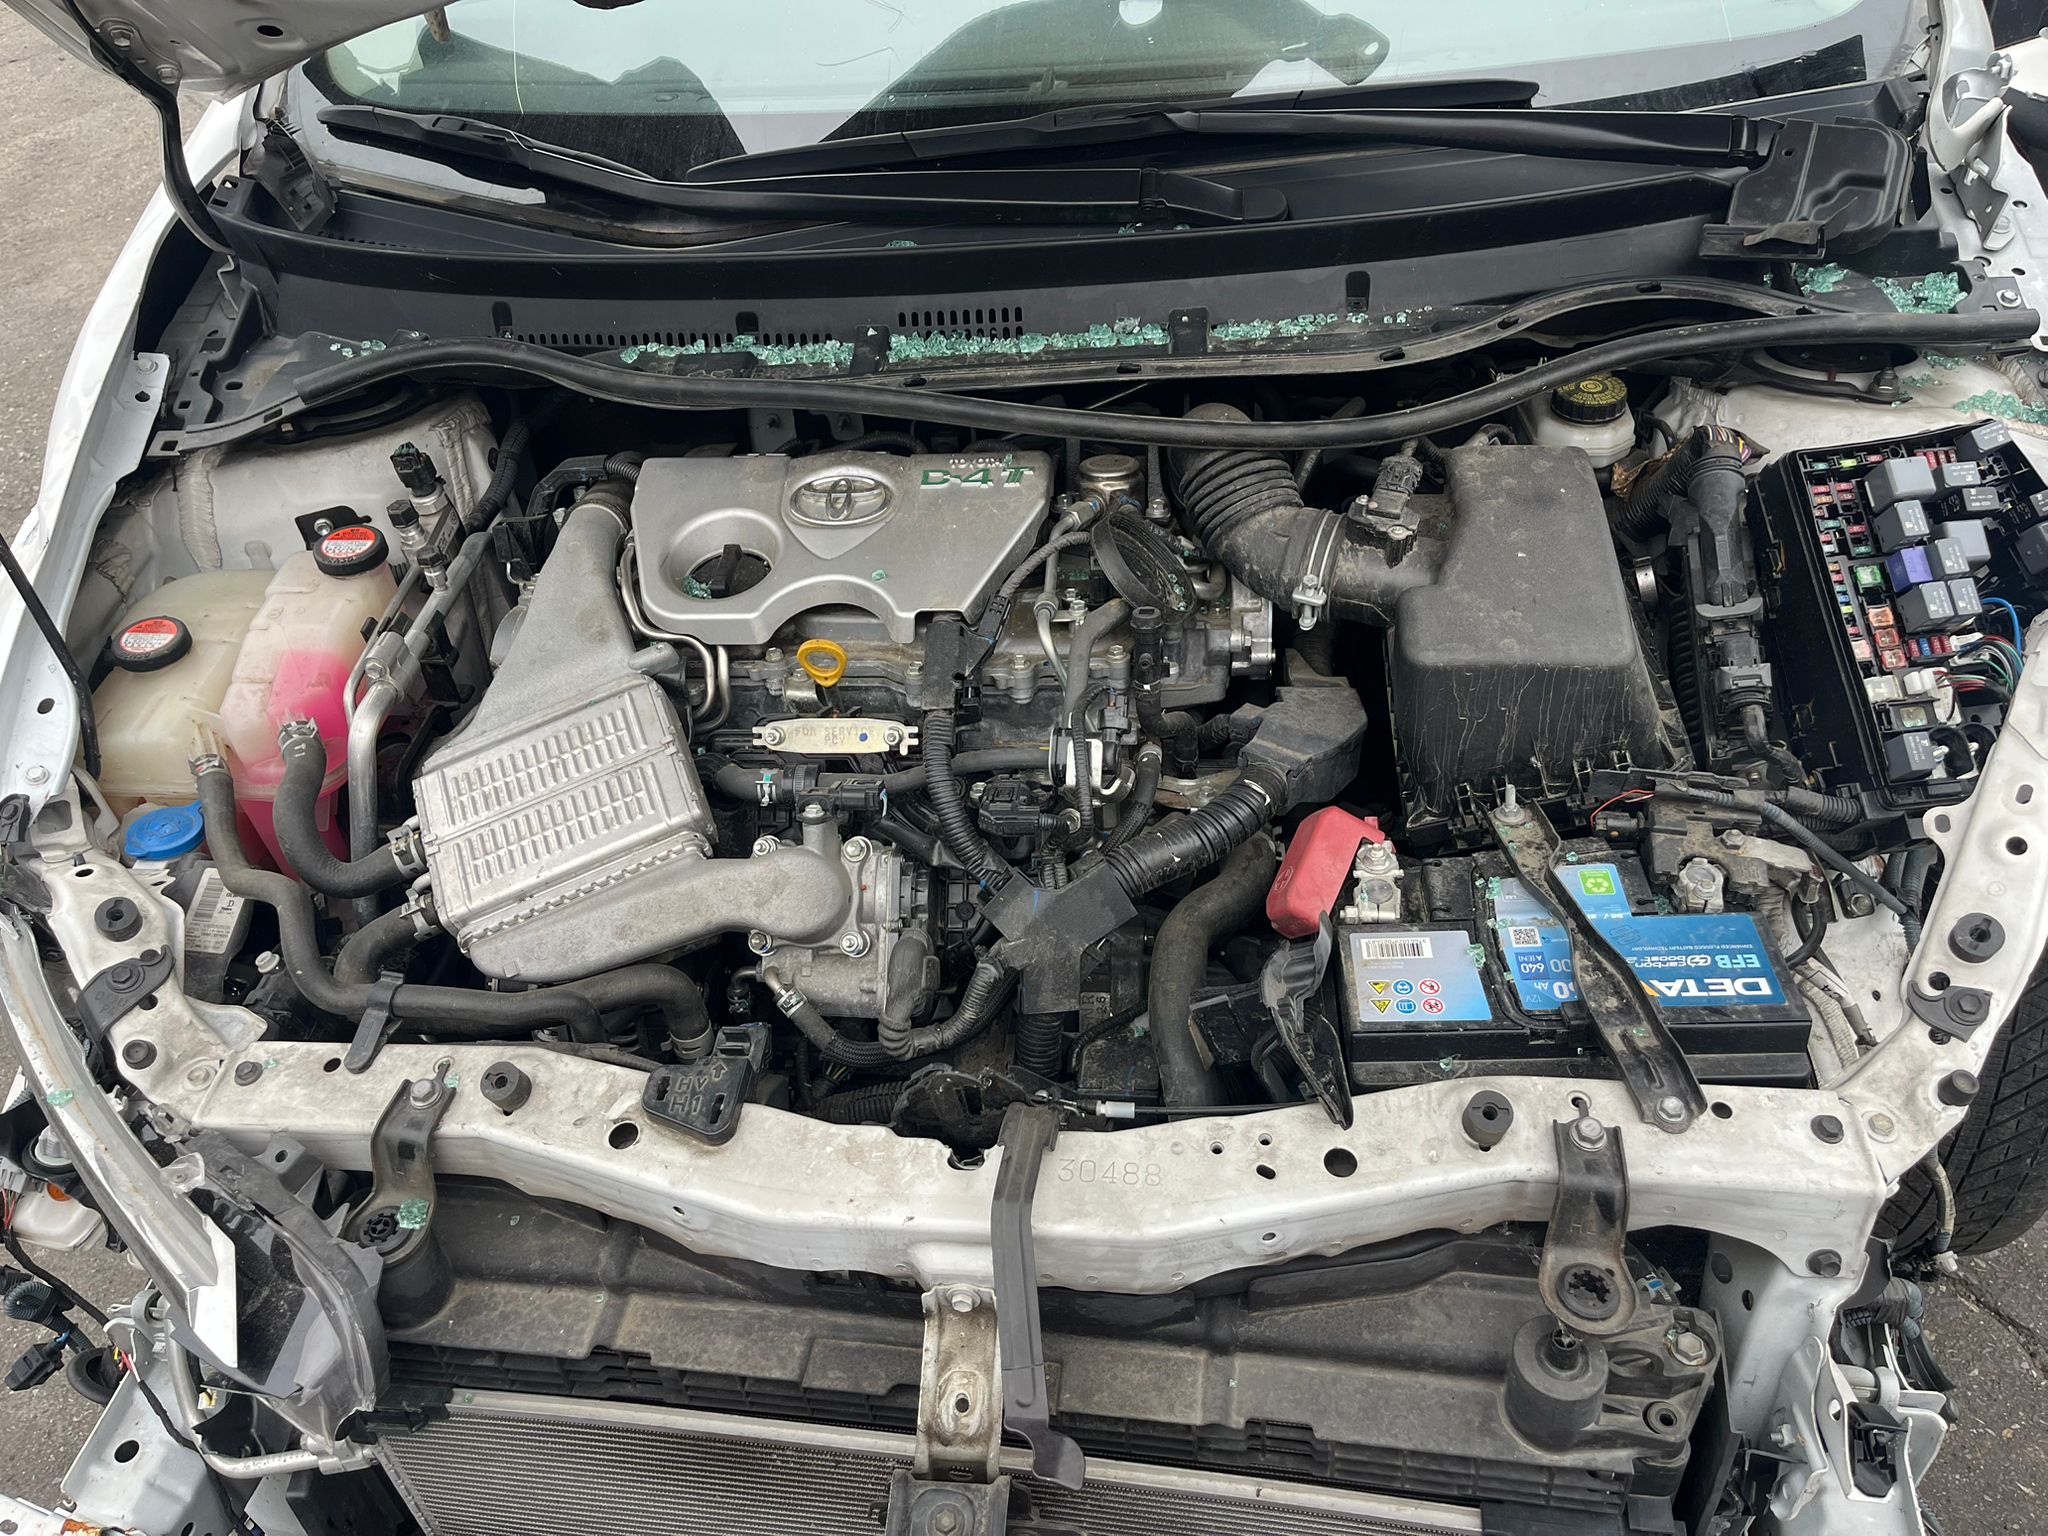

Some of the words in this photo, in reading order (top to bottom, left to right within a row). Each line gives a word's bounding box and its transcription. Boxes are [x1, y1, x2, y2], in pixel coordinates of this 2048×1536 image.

[1645, 954, 1686, 962] boost
[1715, 953, 1761, 969] EFB
[1521, 962, 1545, 973] 640
[1634, 960, 1686, 968] carbon
[1533, 981, 1549, 990] Ah
[1648, 977, 1772, 998] DETA
[1525, 994, 1542, 1003] 12V
[674, 1074, 708, 1092] HV
[1057, 1158, 1162, 1187] 30488
